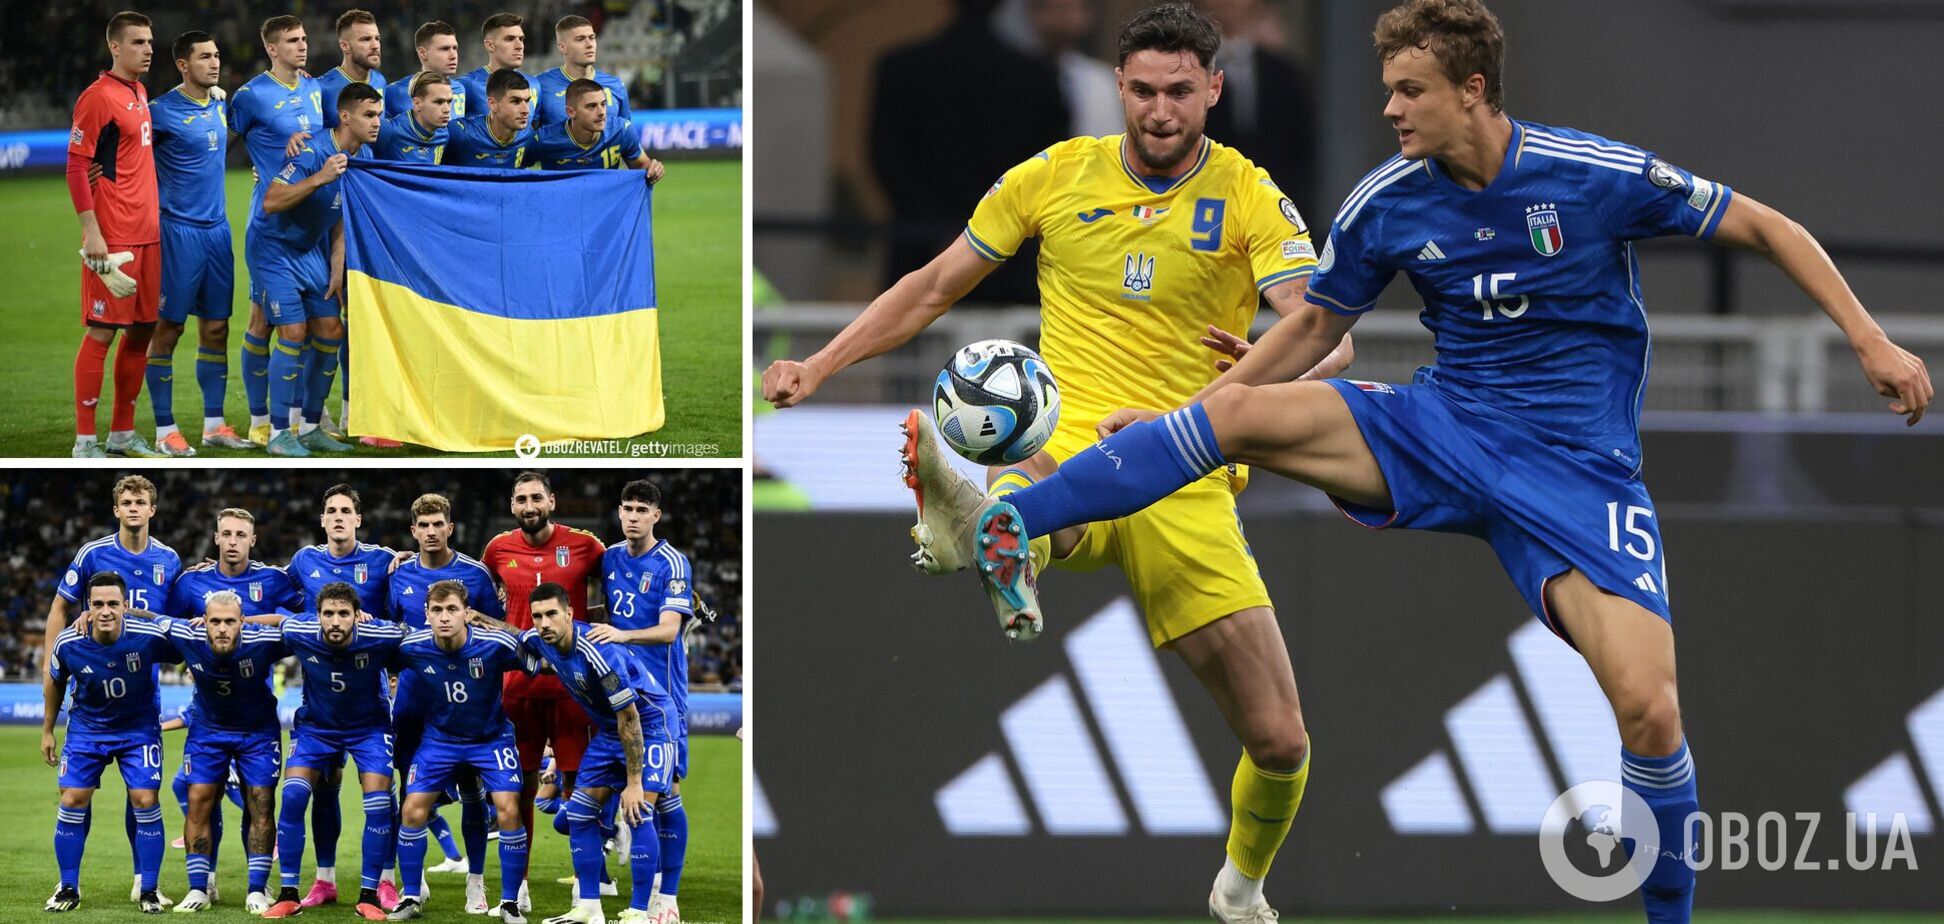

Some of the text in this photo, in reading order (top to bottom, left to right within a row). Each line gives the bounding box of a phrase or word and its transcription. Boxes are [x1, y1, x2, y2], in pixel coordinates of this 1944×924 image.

[141, 121, 151, 146] 12
[1190, 197, 1226, 252] 9
[1530, 214, 1556, 227] ITALIA
[1472, 272, 1529, 320] 15
[1606, 501, 1655, 561] 15
[129, 588, 149, 611] 15
[613, 590, 636, 618] 23
[102, 677, 126, 699] 10
[217, 680, 231, 696] 3
[330, 671, 346, 693] 5
[444, 681, 468, 703] 18
[143, 744, 160, 768] 10
[271, 741, 281, 765] 3
[383, 733, 394, 757] 5
[493, 747, 518, 771] 18
